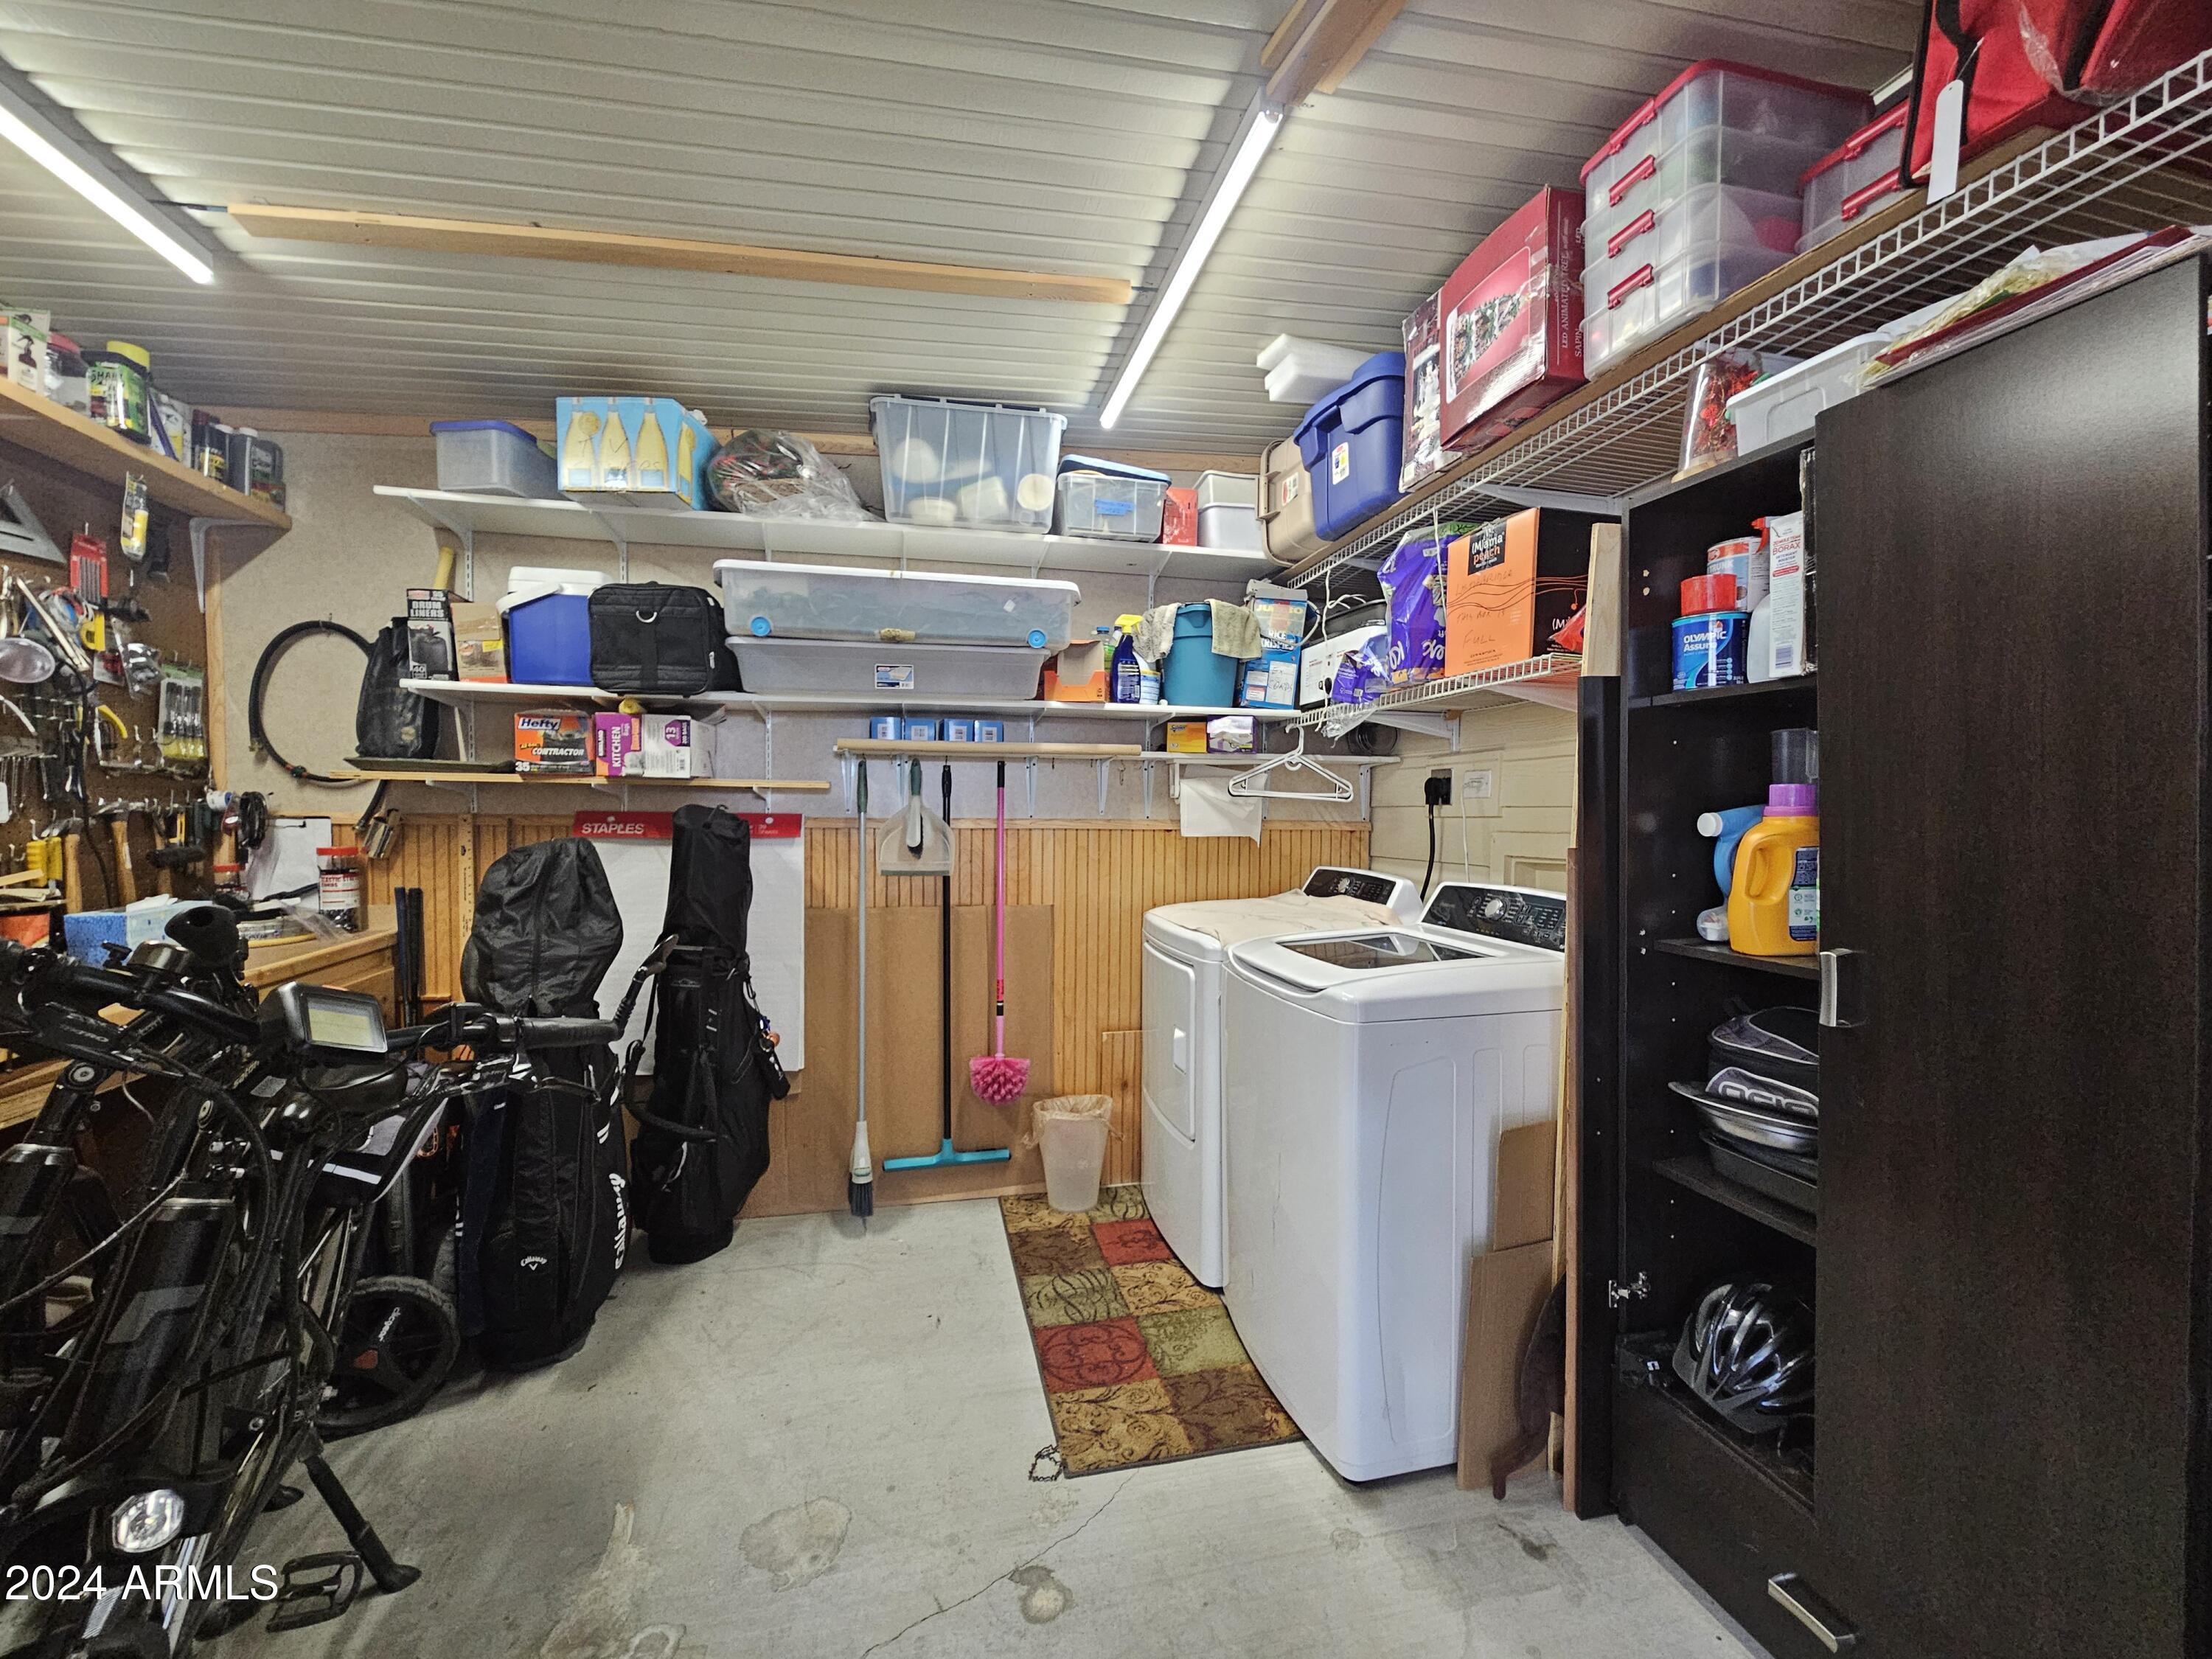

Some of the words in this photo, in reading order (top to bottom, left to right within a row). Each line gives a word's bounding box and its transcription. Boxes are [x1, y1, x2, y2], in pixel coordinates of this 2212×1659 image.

[1773, 541, 1801, 556] BORAX
[411, 600, 442, 609] DRUM
[410, 608, 445, 618] LINERS
[1683, 630, 1727, 644] OLYMPIC
[521, 718, 558, 731] Hefty
[665, 726, 676, 740] 13
[532, 747, 585, 757] CONTRACTOR
[611, 726, 622, 768] KITCHEN
[515, 761, 530, 772] 35
[581, 822, 645, 835] STAPLES
[609, 1173, 627, 1270] Callaway
[520, 1255, 548, 1267] Callaway
